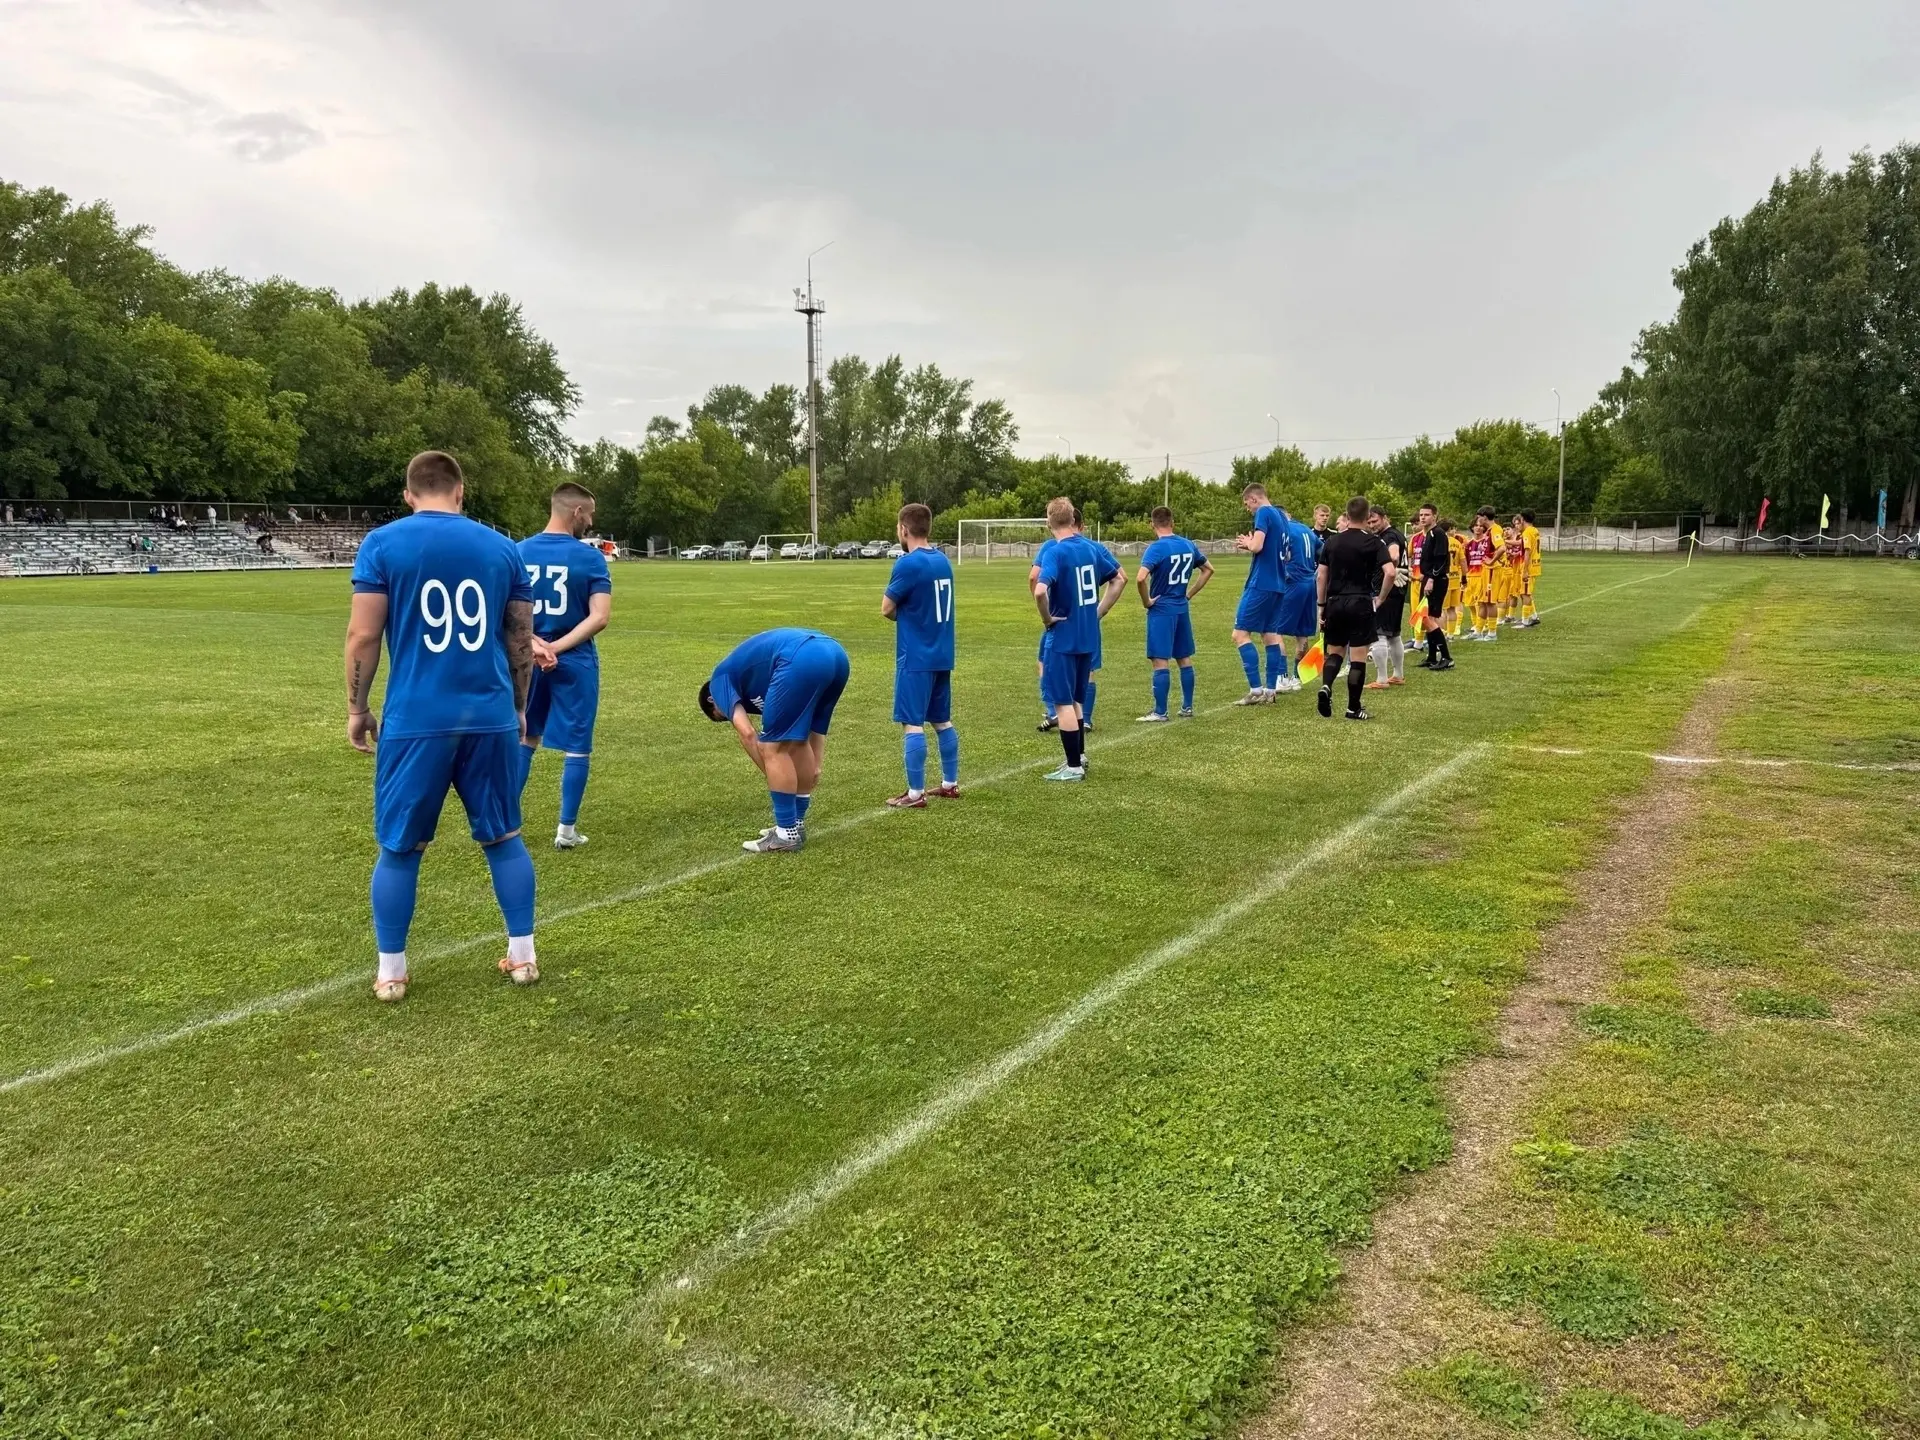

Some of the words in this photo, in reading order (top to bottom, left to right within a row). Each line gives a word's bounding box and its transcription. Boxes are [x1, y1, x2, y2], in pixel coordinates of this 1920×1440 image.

[1302, 533, 1311, 559] 11
[1075, 564, 1097, 607] 19
[1168, 553, 1193, 585] 22
[420, 578, 487, 653] 99
[933, 578, 952, 623] 17
